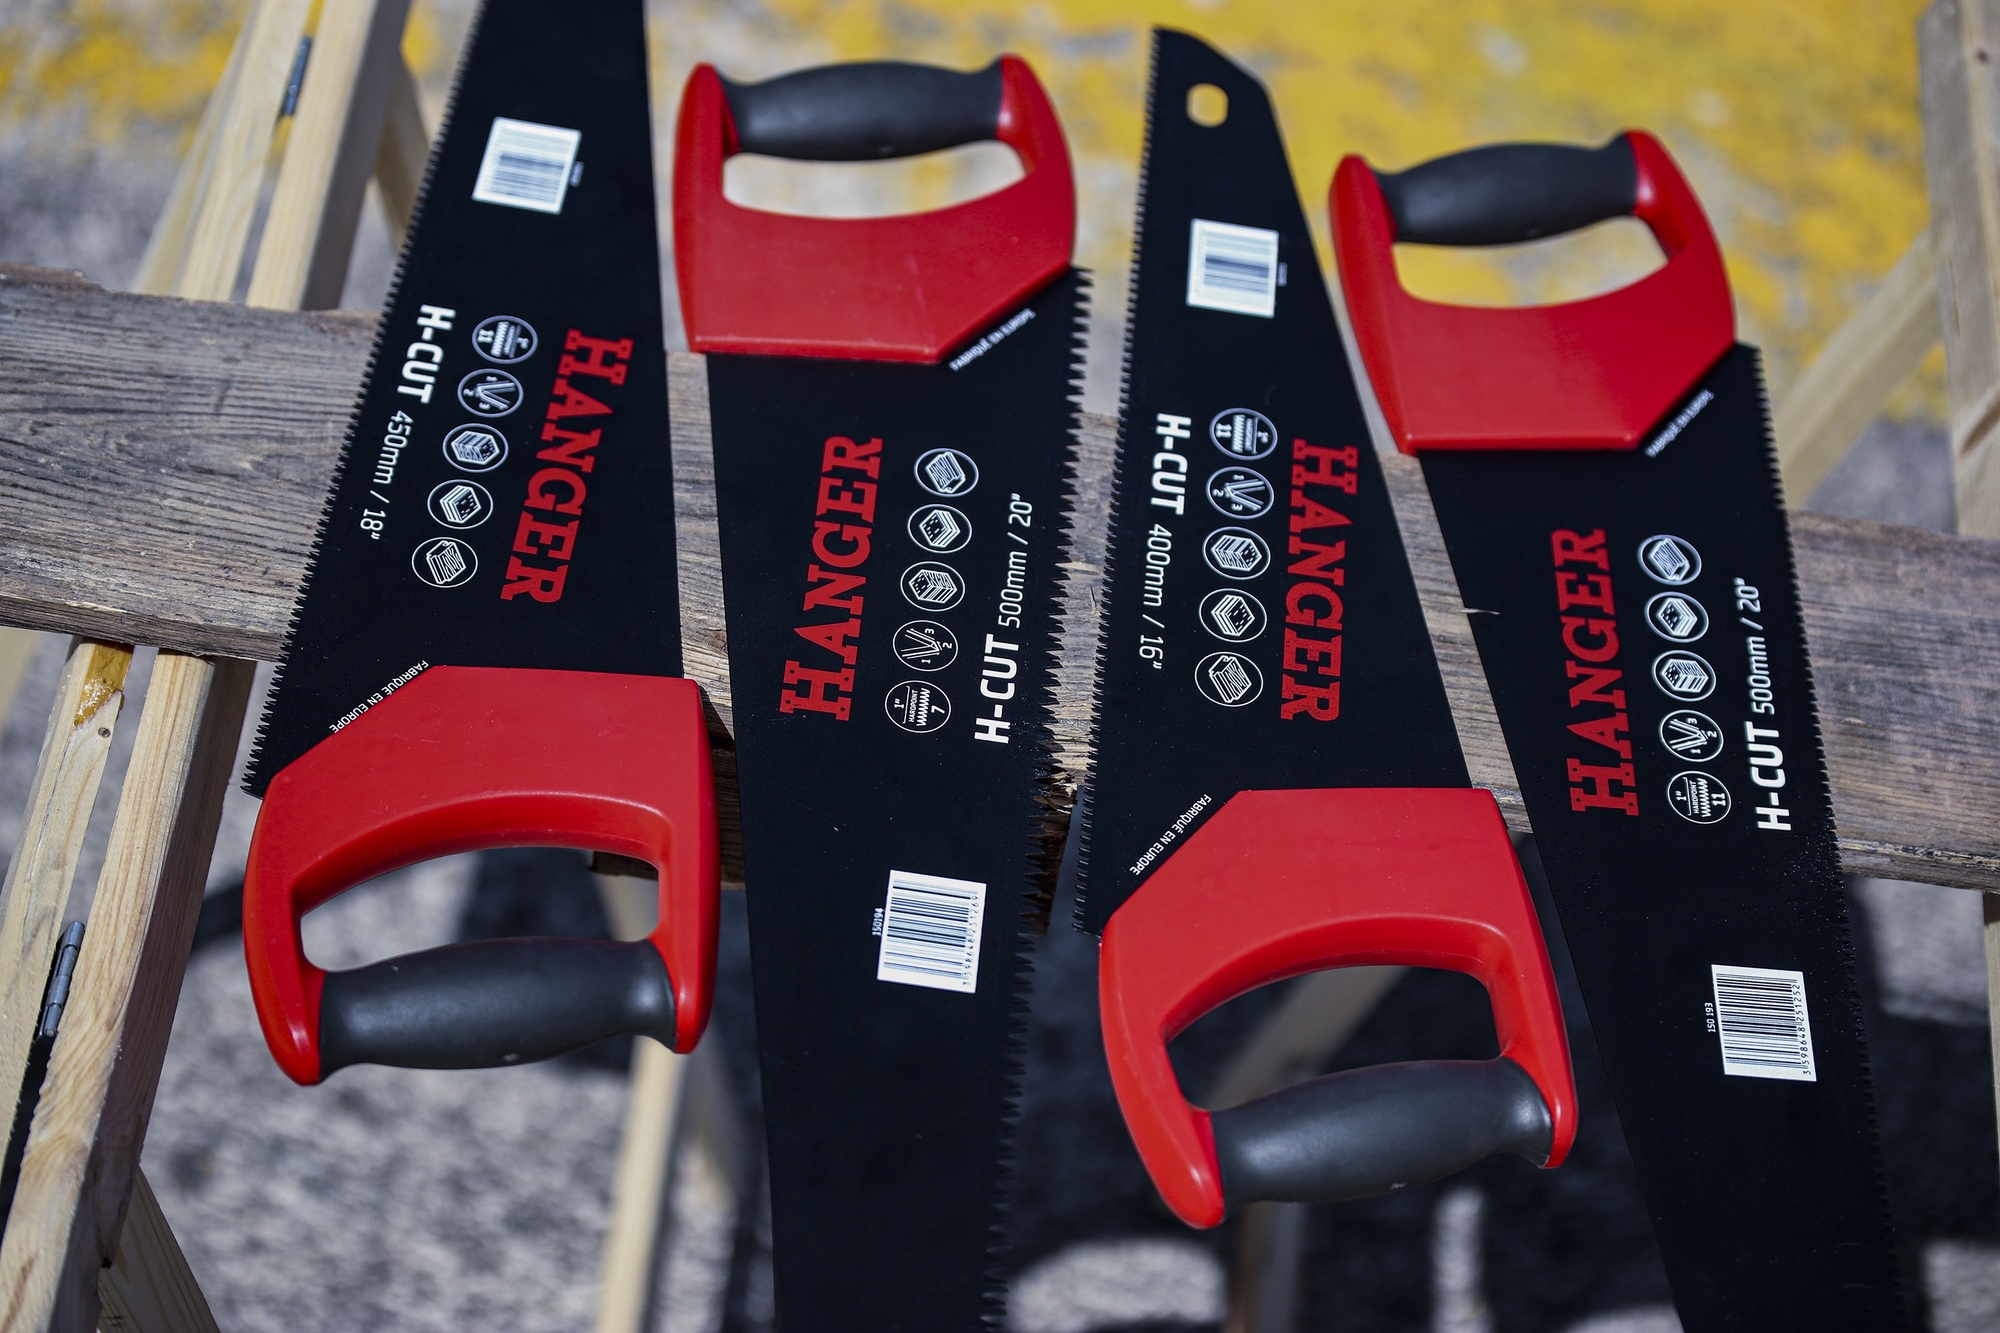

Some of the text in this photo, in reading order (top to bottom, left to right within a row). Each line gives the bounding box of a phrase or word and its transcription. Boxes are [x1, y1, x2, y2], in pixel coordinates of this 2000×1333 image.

[397, 304, 456, 404] H-CUT
[373, 410, 414, 485] 450mm
[500, 328, 634, 603] HANGER
[1150, 413, 1192, 516] H-CUT
[779, 436, 883, 722] HANGER
[1143, 523, 1172, 608] 400mm
[1280, 438, 1359, 722] HANGER
[974, 633, 1019, 744] H-CUT
[998, 551, 1028, 628] 500mm
[1552, 528, 1639, 816] HANGER
[1746, 636, 1775, 715] 500mm
[329, 703, 369, 733] EUROPE
[366, 692, 384, 706] EN
[908, 689, 918, 723] HARDPOINT
[931, 705, 945, 714] 7
[1689, 780, 1699, 814] HARDPOINT
[1711, 793, 1726, 806] 11
[1744, 721, 1791, 831] H-CUT
[1128, 794, 1212, 876] FABRIQUÉ EN EUROPE
[1704, 1002, 1716, 1033] 150 193
